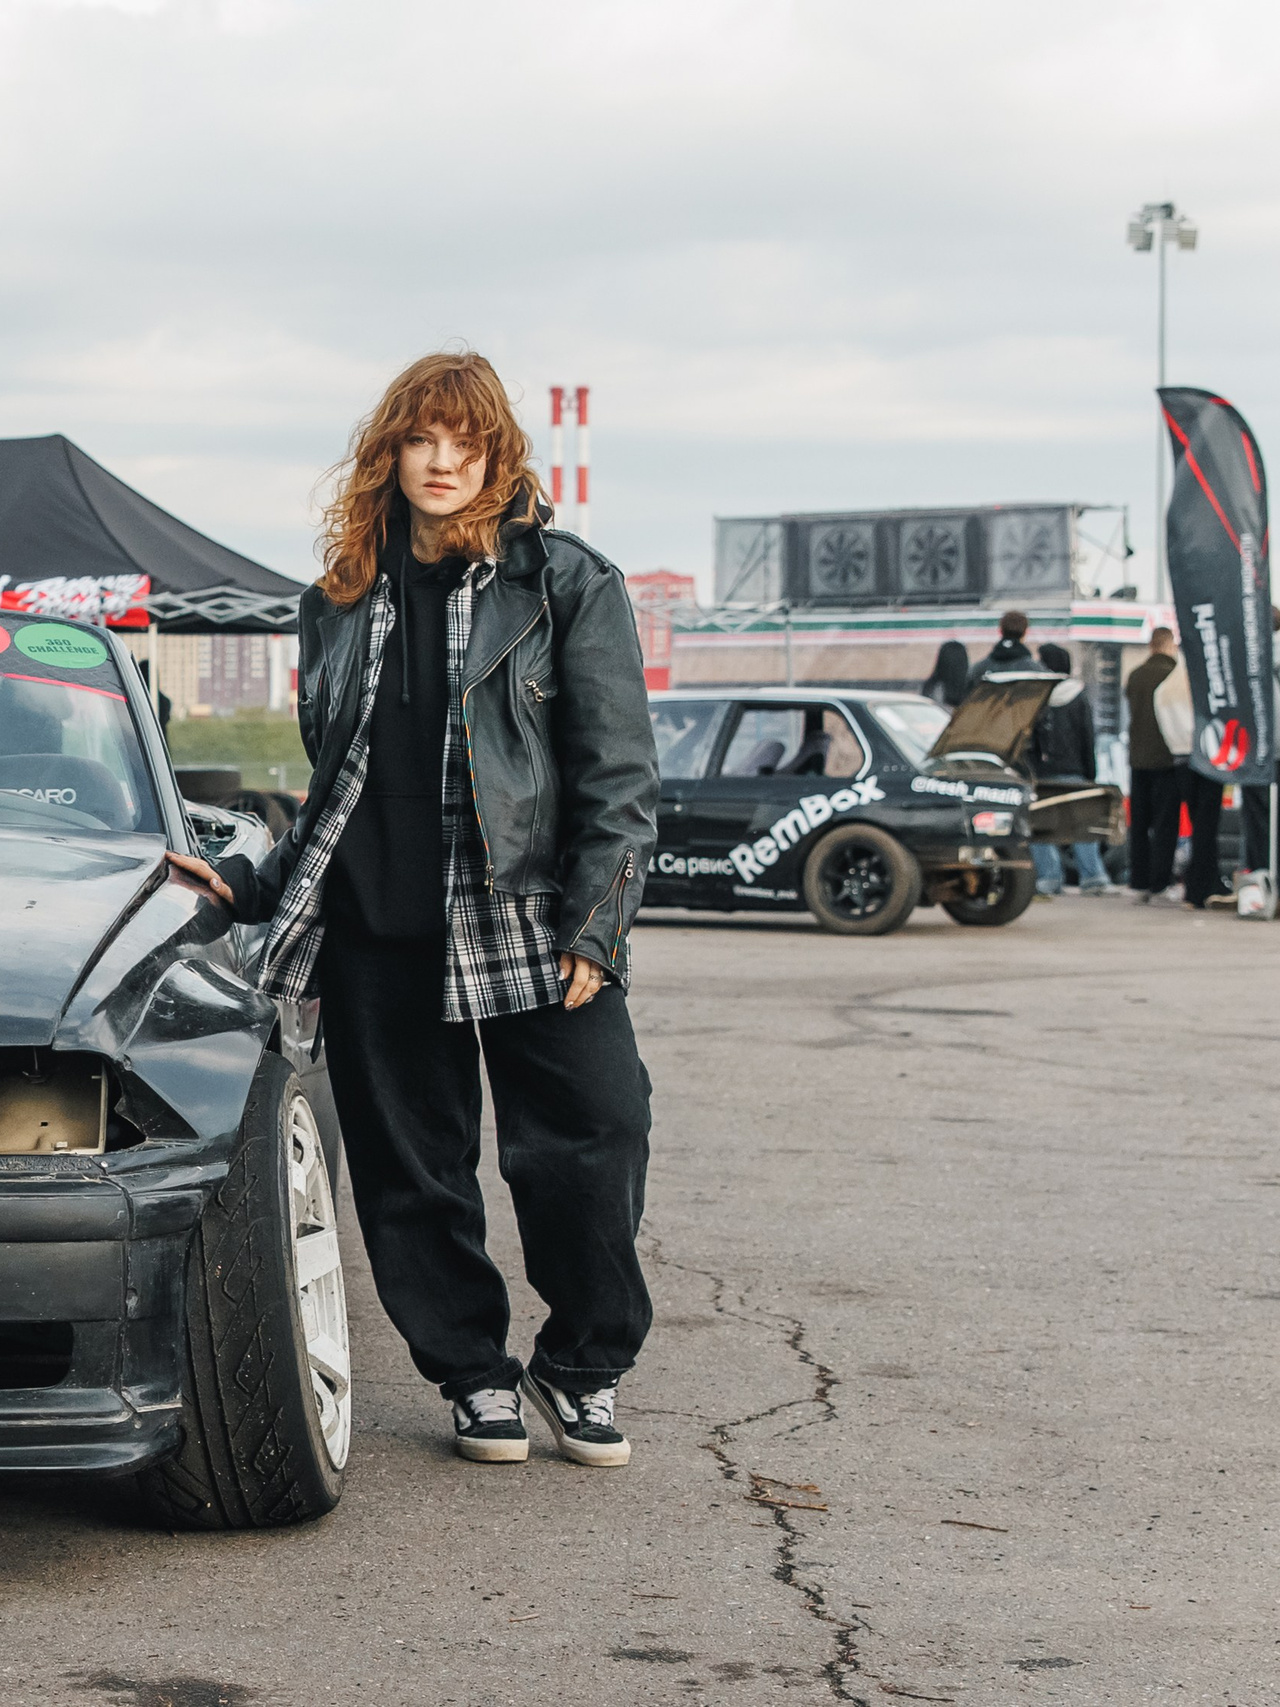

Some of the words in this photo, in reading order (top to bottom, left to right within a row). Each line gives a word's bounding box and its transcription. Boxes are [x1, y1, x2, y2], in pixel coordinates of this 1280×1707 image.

[45, 638, 72, 646] 360
[28, 645, 100, 655] CHALLENGE
[728, 774, 887, 884] RemBox
